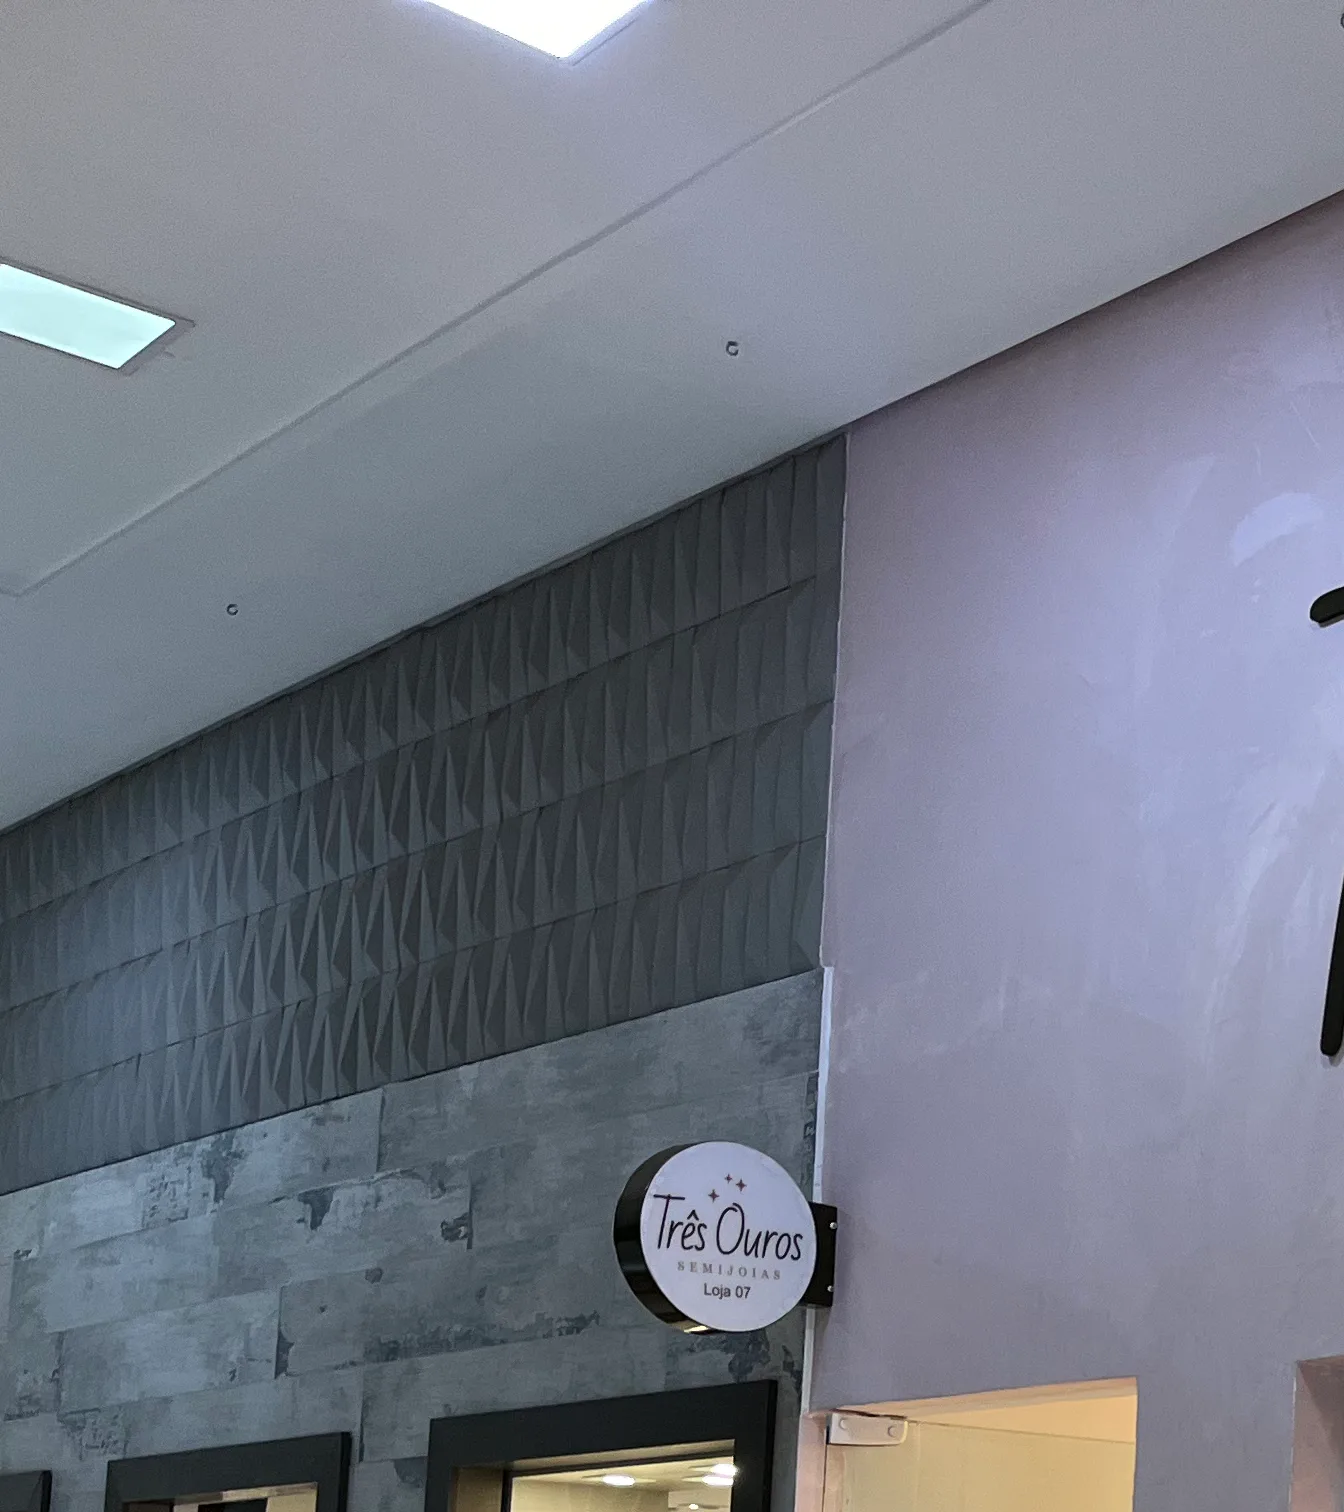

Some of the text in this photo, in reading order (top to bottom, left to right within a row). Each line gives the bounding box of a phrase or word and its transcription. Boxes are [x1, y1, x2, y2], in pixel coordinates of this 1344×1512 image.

[653, 1194, 804, 1261] Três Ouros
[677, 1260, 782, 1281] SEMIJOIAS
[703, 1282, 752, 1300] Loja 07
